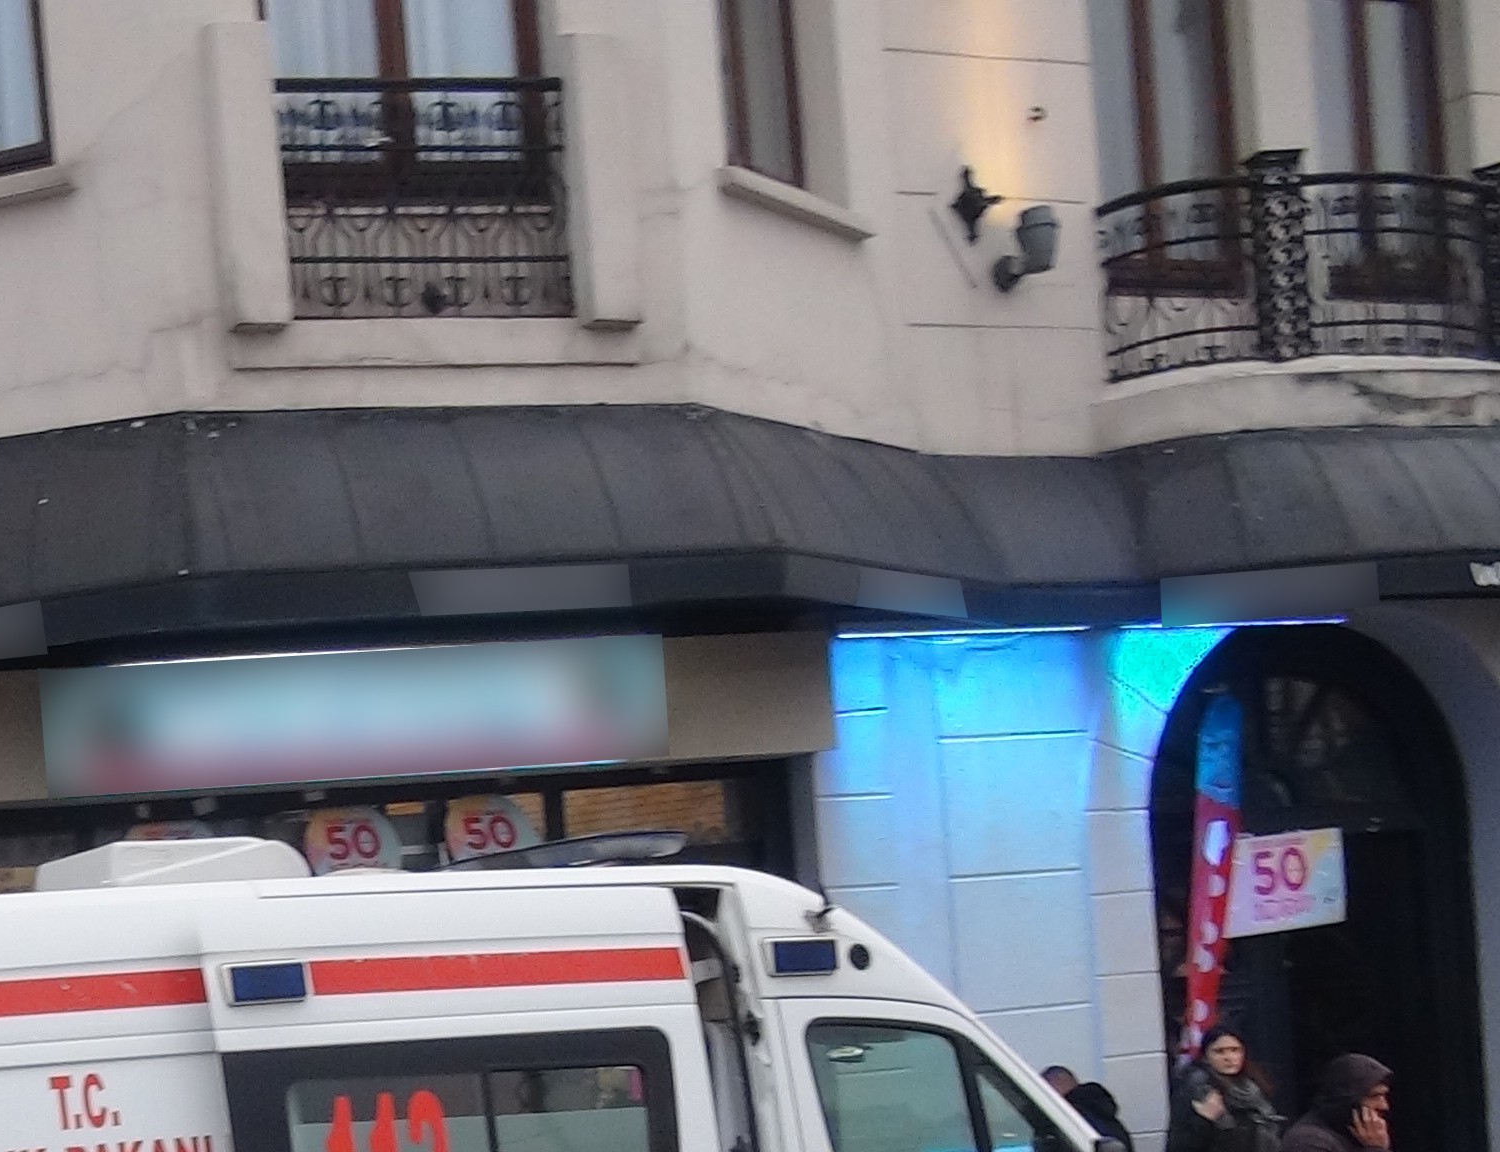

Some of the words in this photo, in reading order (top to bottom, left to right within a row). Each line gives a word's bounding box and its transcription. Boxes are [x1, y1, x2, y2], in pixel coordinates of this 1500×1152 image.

[327, 819, 382, 861] 50
[463, 814, 517, 850] 50
[1253, 846, 1308, 896] 50
[49, 1073, 122, 1131] T.C.
